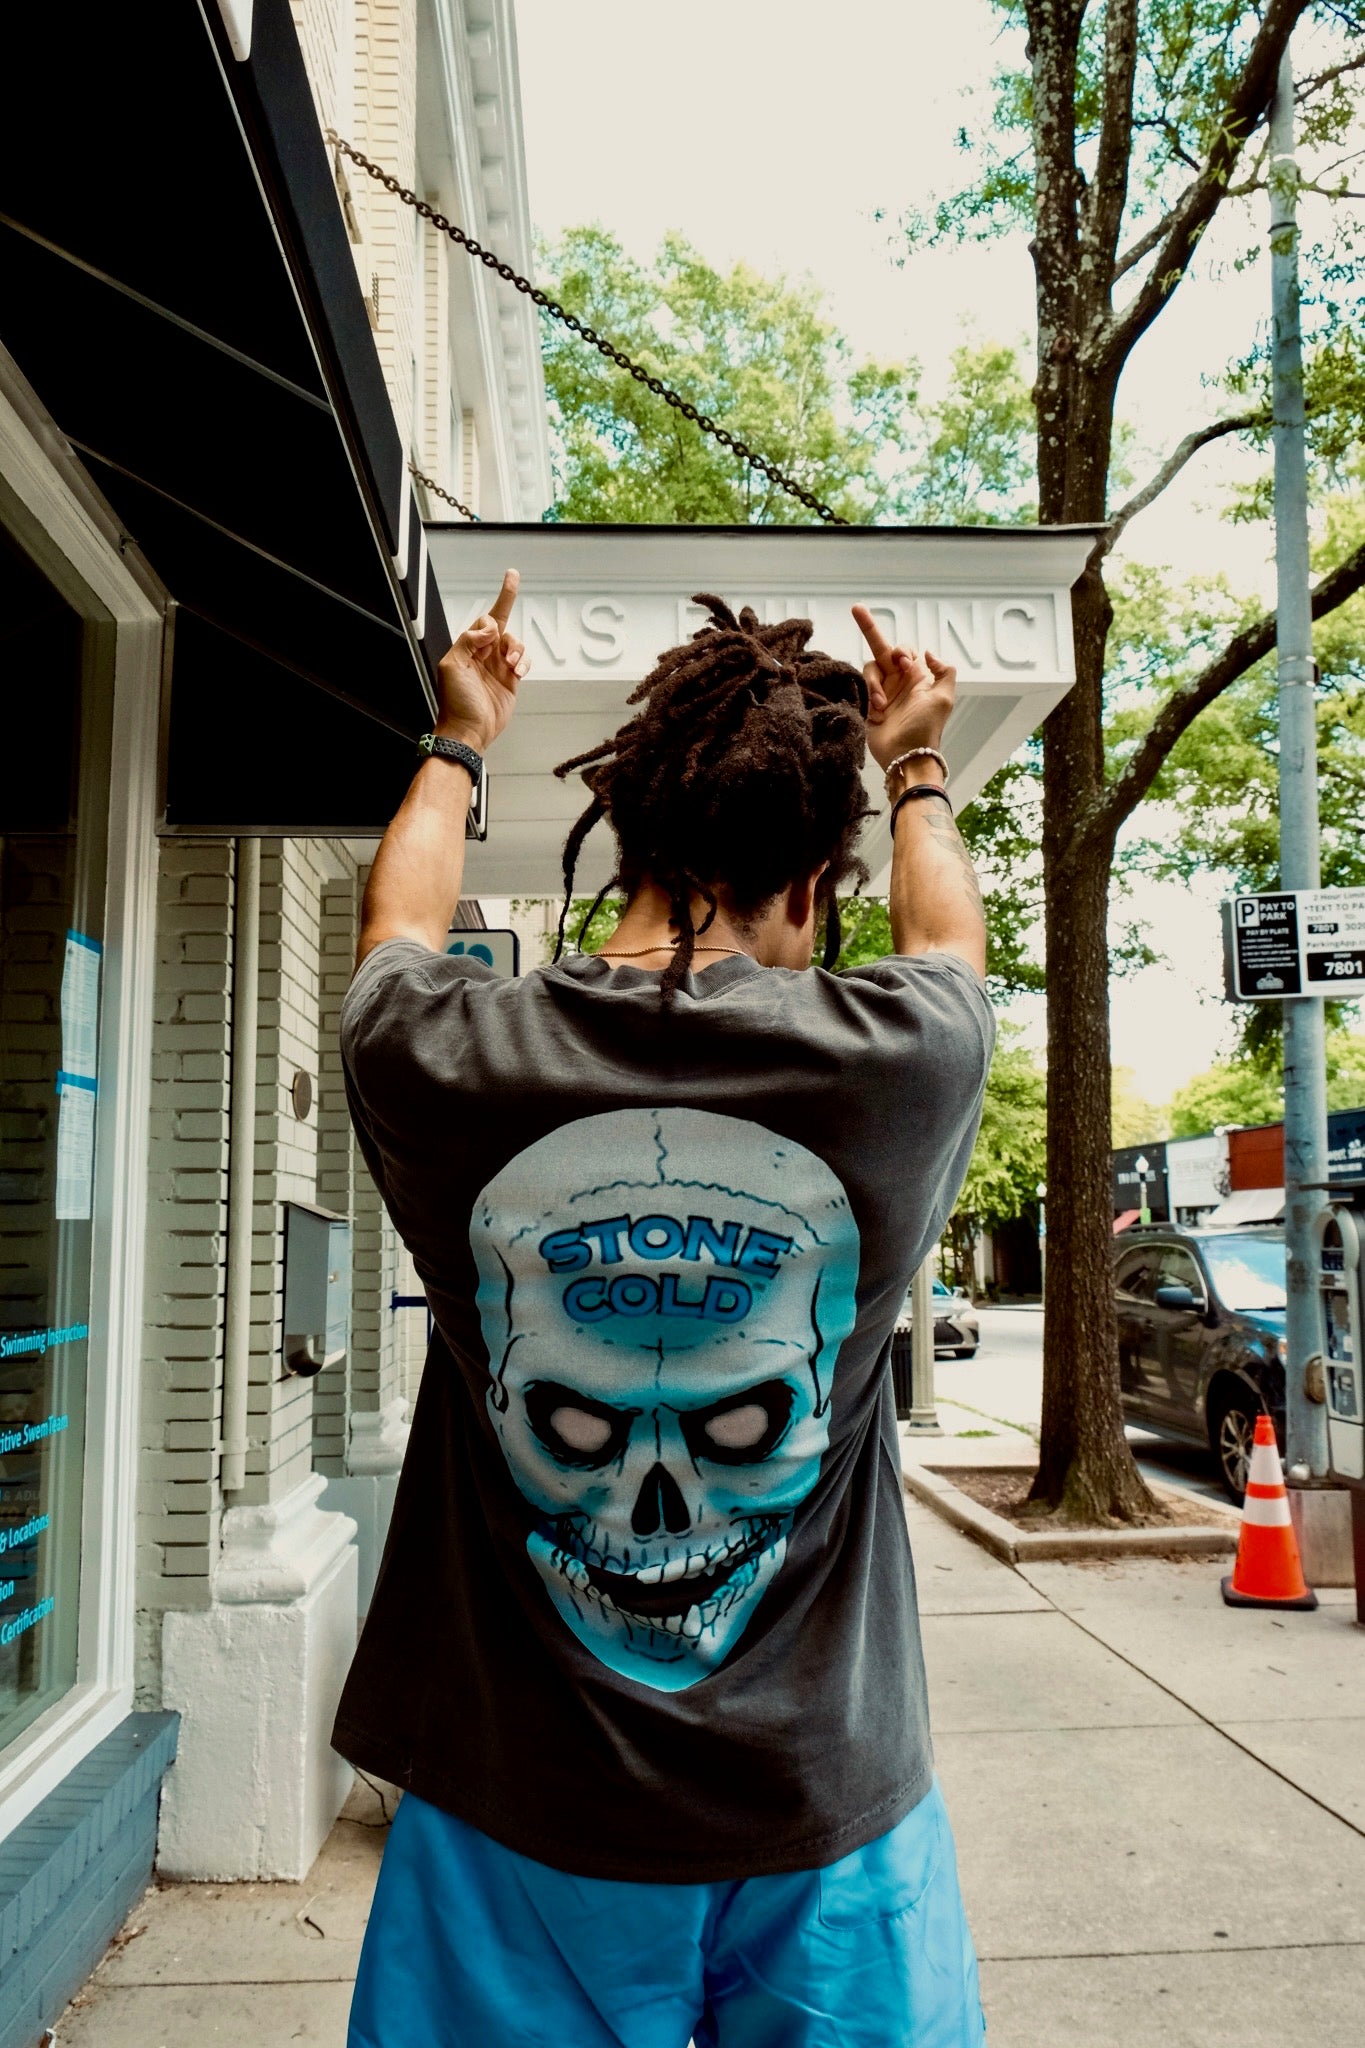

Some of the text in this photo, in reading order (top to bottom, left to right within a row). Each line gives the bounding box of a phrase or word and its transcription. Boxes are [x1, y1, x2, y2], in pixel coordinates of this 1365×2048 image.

[1241, 902, 1255, 924] P
[1259, 901, 1295, 912] PAY TO
[1260, 911, 1287, 921] PARK
[1336, 903, 1349, 911] TO
[1270, 927, 1289, 935] PLATE
[1324, 960, 1362, 976] 7801
[539, 1213, 793, 1279] STONE
[562, 1272, 751, 1323] COLD
[0, 1322, 88, 1358] Swimming Instruction
[9, 1514, 50, 1548] Locations
[0, 1580, 14, 1602] ion
[1, 1597, 54, 1645] Certification
